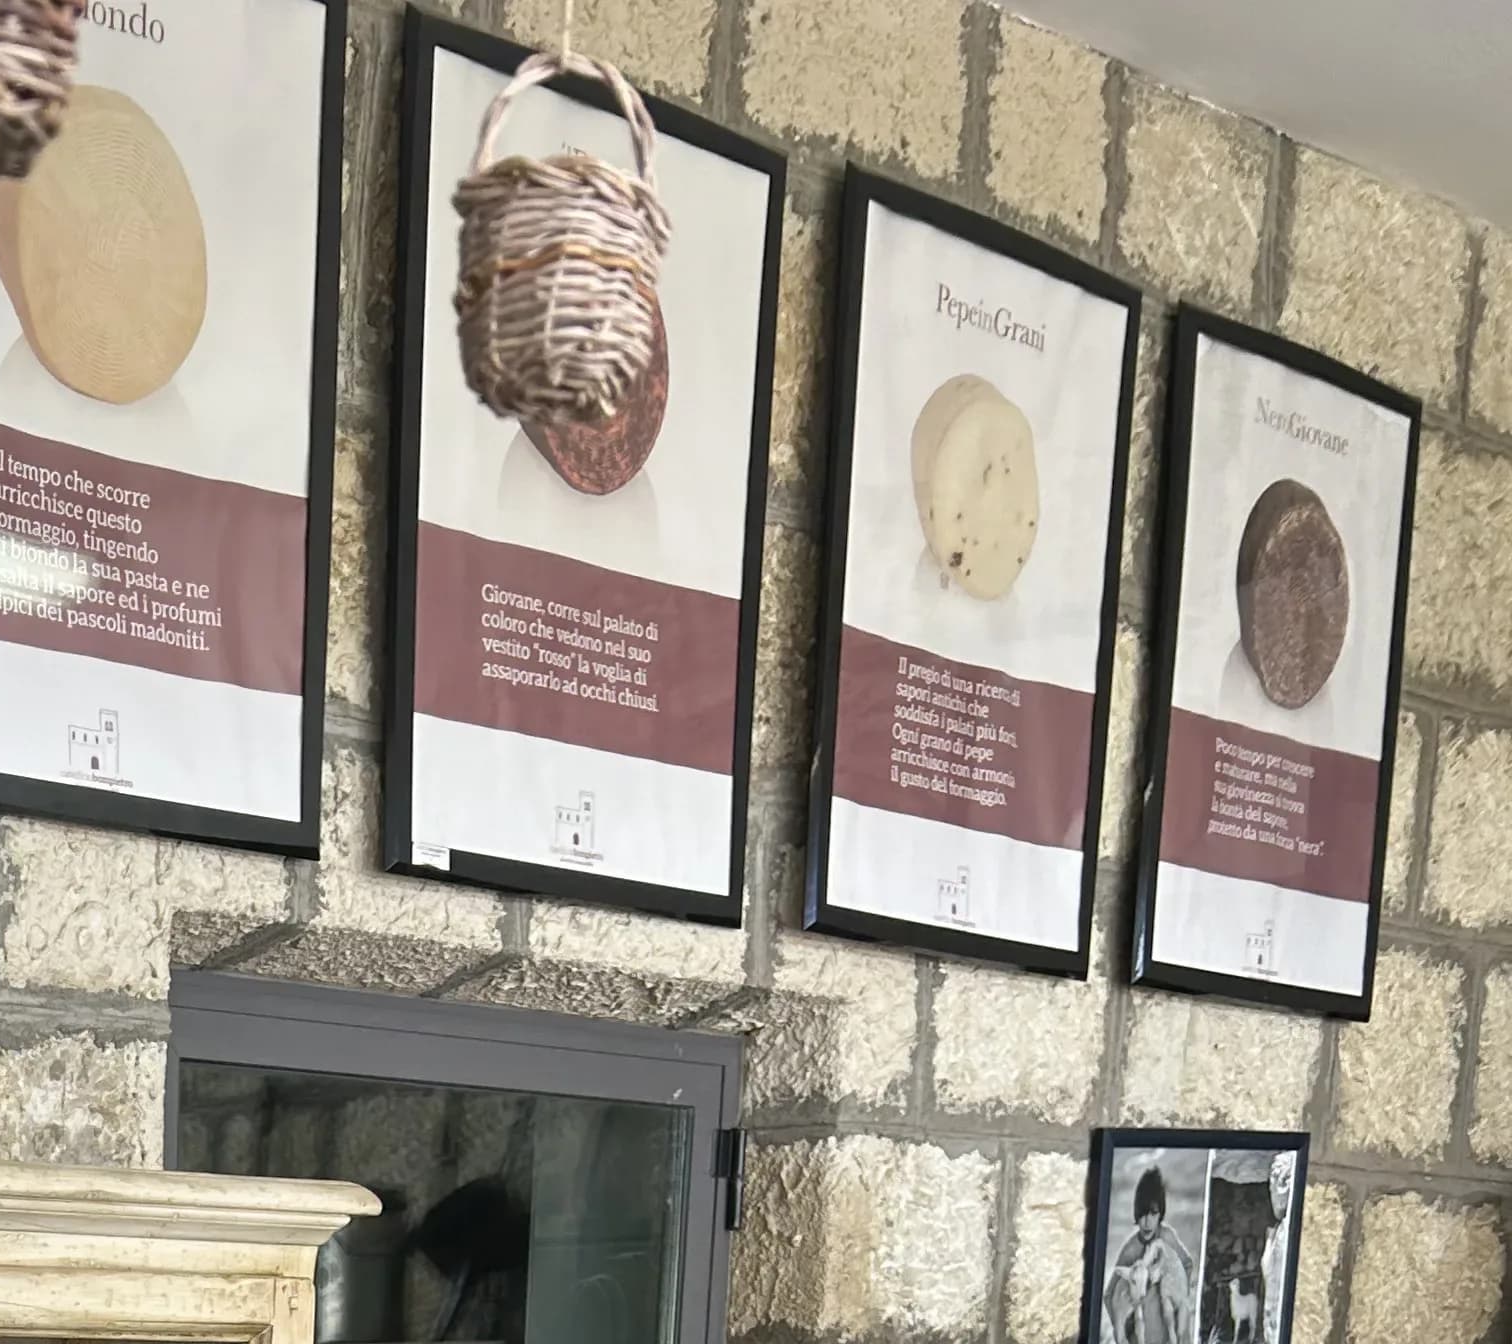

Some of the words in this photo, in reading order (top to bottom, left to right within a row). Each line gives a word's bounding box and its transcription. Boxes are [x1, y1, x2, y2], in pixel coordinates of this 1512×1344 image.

[7, 454, 61, 487] tempo
[64, 470, 94, 496] che
[97, 481, 151, 510] scorre
[86, 508, 142, 534] questo
[83, 529, 159, 566] tingendo
[10, 538, 69, 571] biondo
[72, 551, 88, 577] la
[91, 560, 121, 583] sua
[124, 567, 168, 593] pasta
[171, 578, 183, 595] e
[186, 581, 210, 600] ne
[37, 595, 64, 622] dei
[67, 607, 127, 635] pascoli
[130, 619, 210, 651] madoniti.
[58, 581, 115, 607] sapore
[118, 588, 138, 612] ed
[142, 594, 149, 614] i
[152, 598, 222, 627] profumi
[481, 583, 546, 615] Giovane,
[548, 600, 580, 622] corre
[583, 610, 601, 628] sul
[603, 614, 644, 638] palato
[646, 622, 659, 641] di
[481, 610, 527, 634] coloro
[529, 619, 554, 640] che
[556, 628, 603, 652] vedono
[605, 639, 625, 658] nel
[627, 645, 652, 663] suo
[481, 636, 531, 660] vestito
[578, 654, 590, 674] la
[592, 660, 632, 685] voglia
[634, 667, 647, 686] di
[908, 662, 940, 685] pregio
[941, 669, 951, 687] di
[953, 679, 973, 694] una
[481, 661, 560, 691] assaporarlo
[562, 677, 578, 696] ad
[580, 683, 616, 704] occhi
[618, 688, 660, 713] chiusi.
[896, 682, 931, 702] sapori
[932, 692, 966, 716] antichi
[968, 700, 989, 718] che
[892, 723, 919, 744] Ogni
[920, 732, 951, 752] grano
[953, 737, 963, 755] di
[964, 744, 994, 762] pepe
[894, 704, 938, 727] soddisfa
[945, 716, 974, 736] palati
[975, 723, 997, 741] più
[891, 747, 949, 773] arricchisce
[950, 763, 970, 778] con
[900, 769, 930, 789] gusto
[931, 775, 948, 794] del
